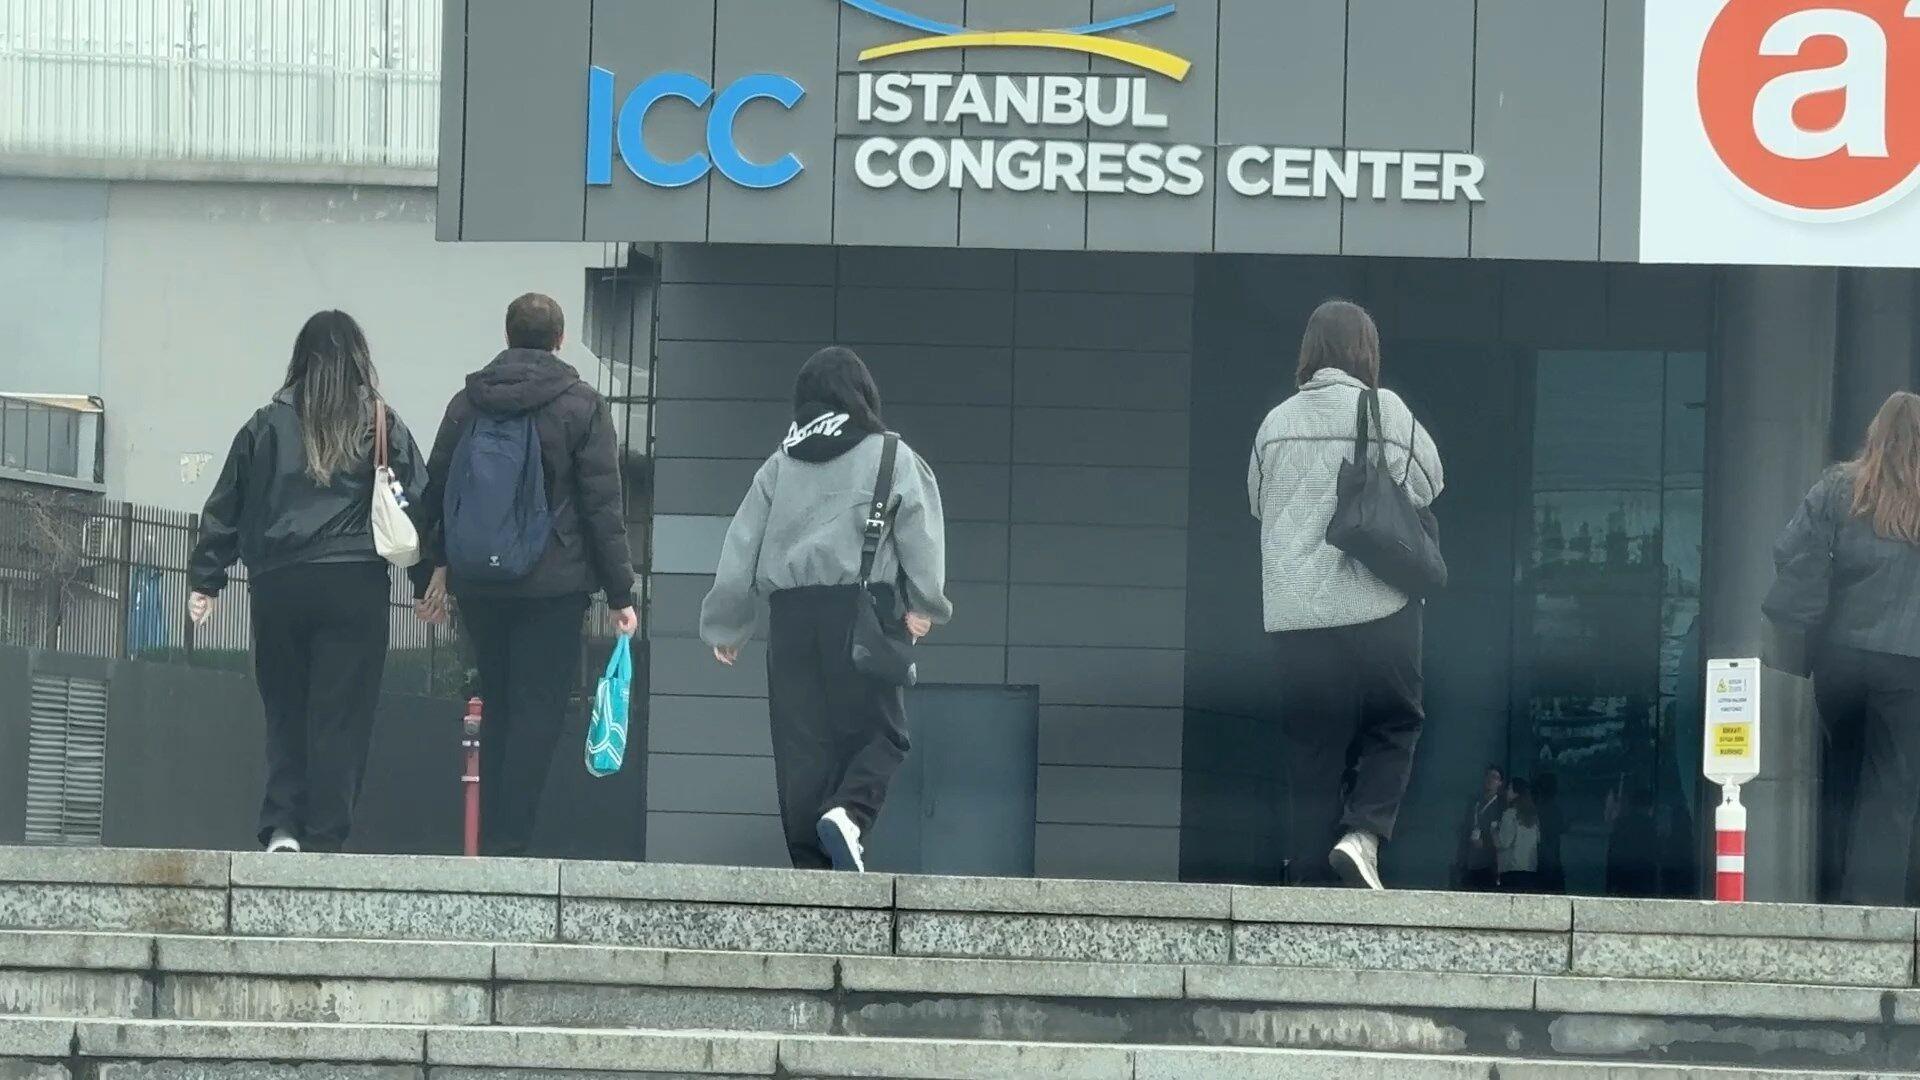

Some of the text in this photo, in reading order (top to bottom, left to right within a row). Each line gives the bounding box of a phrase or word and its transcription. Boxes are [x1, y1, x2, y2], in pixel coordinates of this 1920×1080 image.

[586, 65, 806, 188] ICC
[857, 72, 1169, 128] ISTANBUL
[854, 136, 1486, 202] CONGRESS CENTER
